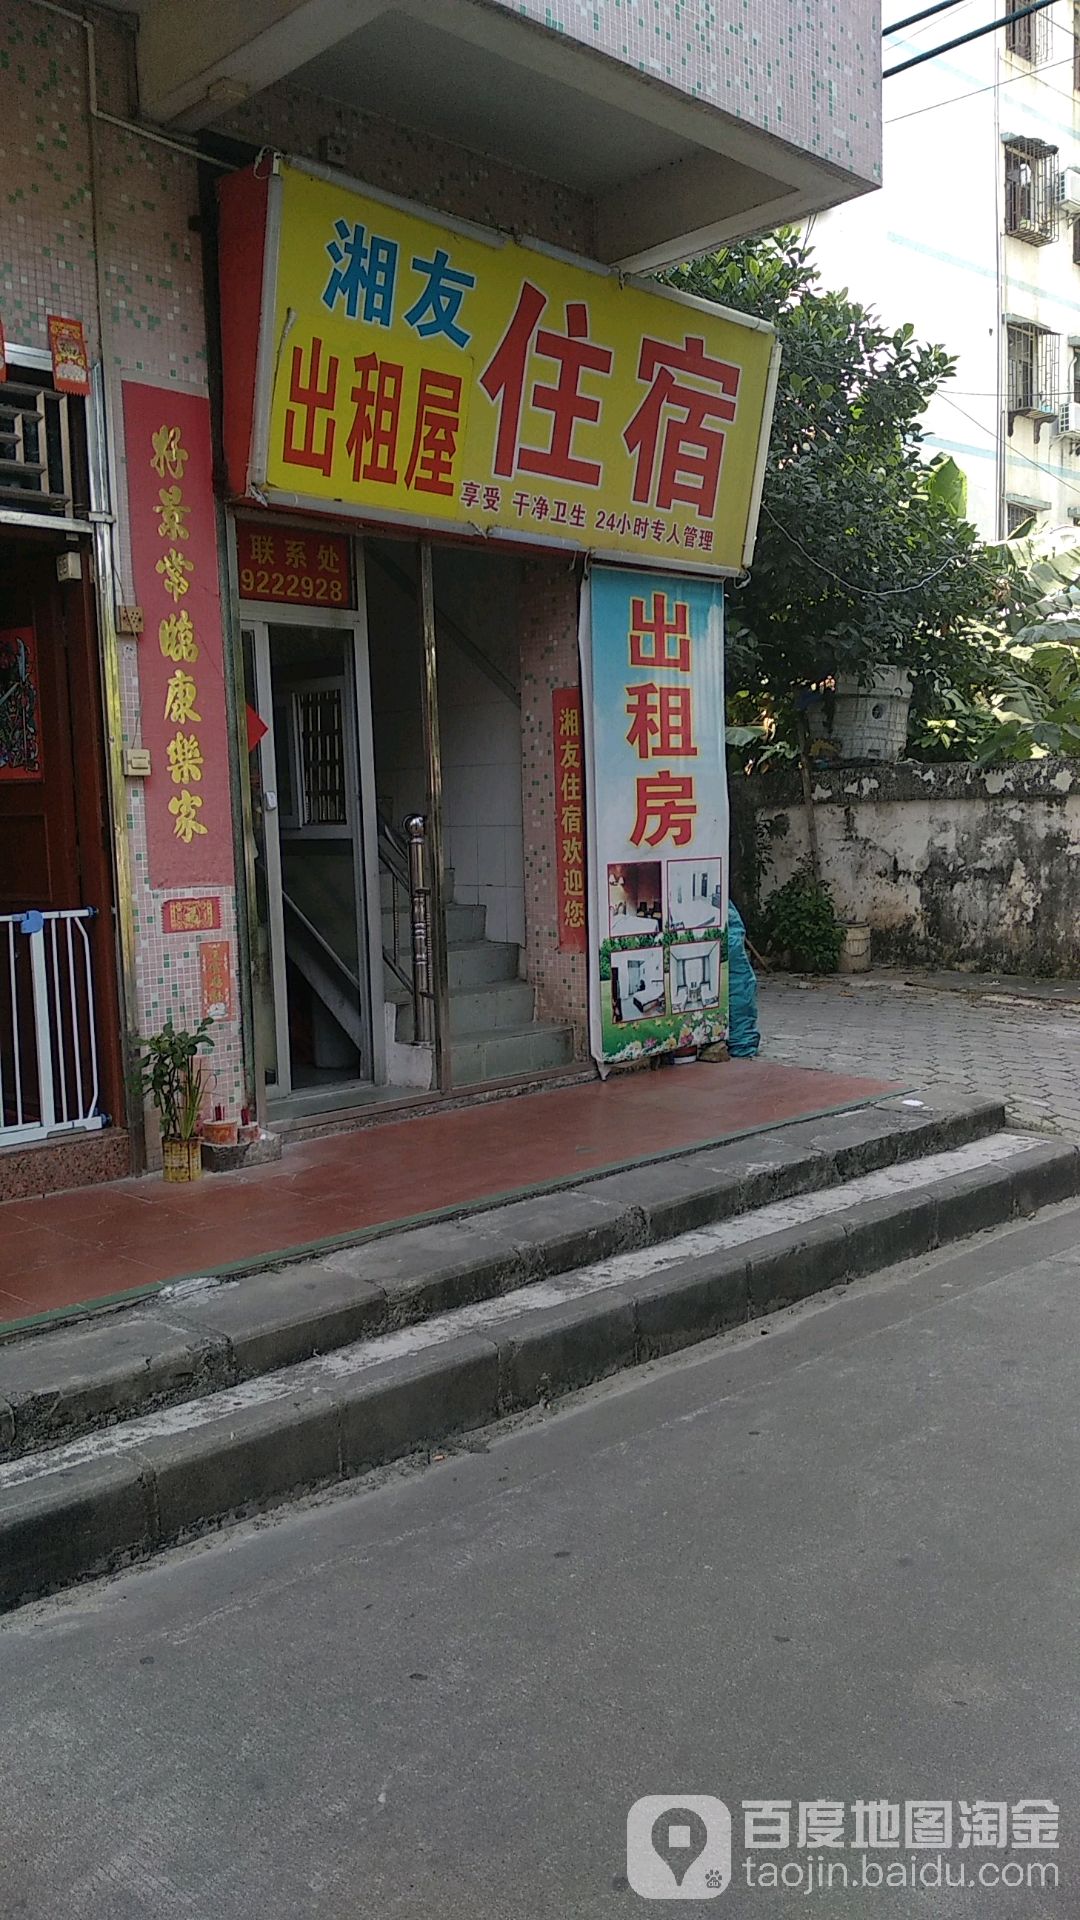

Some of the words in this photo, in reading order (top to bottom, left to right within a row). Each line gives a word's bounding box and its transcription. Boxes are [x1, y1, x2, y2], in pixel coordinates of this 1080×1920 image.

[322, 218, 475, 348] 湘友
[283, 337, 463, 497] 出租屋
[480, 281, 741, 518] 住宿
[240, 568, 343, 602] 9222928
[249, 534, 340, 574] 联系处
[460, 481, 501, 512] 享受
[512, 492, 586, 528] 干净卫生
[595, 510, 714, 551] 24小时专人管理
[625, 591, 698, 848] 出租房
[559, 708, 585, 928] 湘友住宿欢迎您
